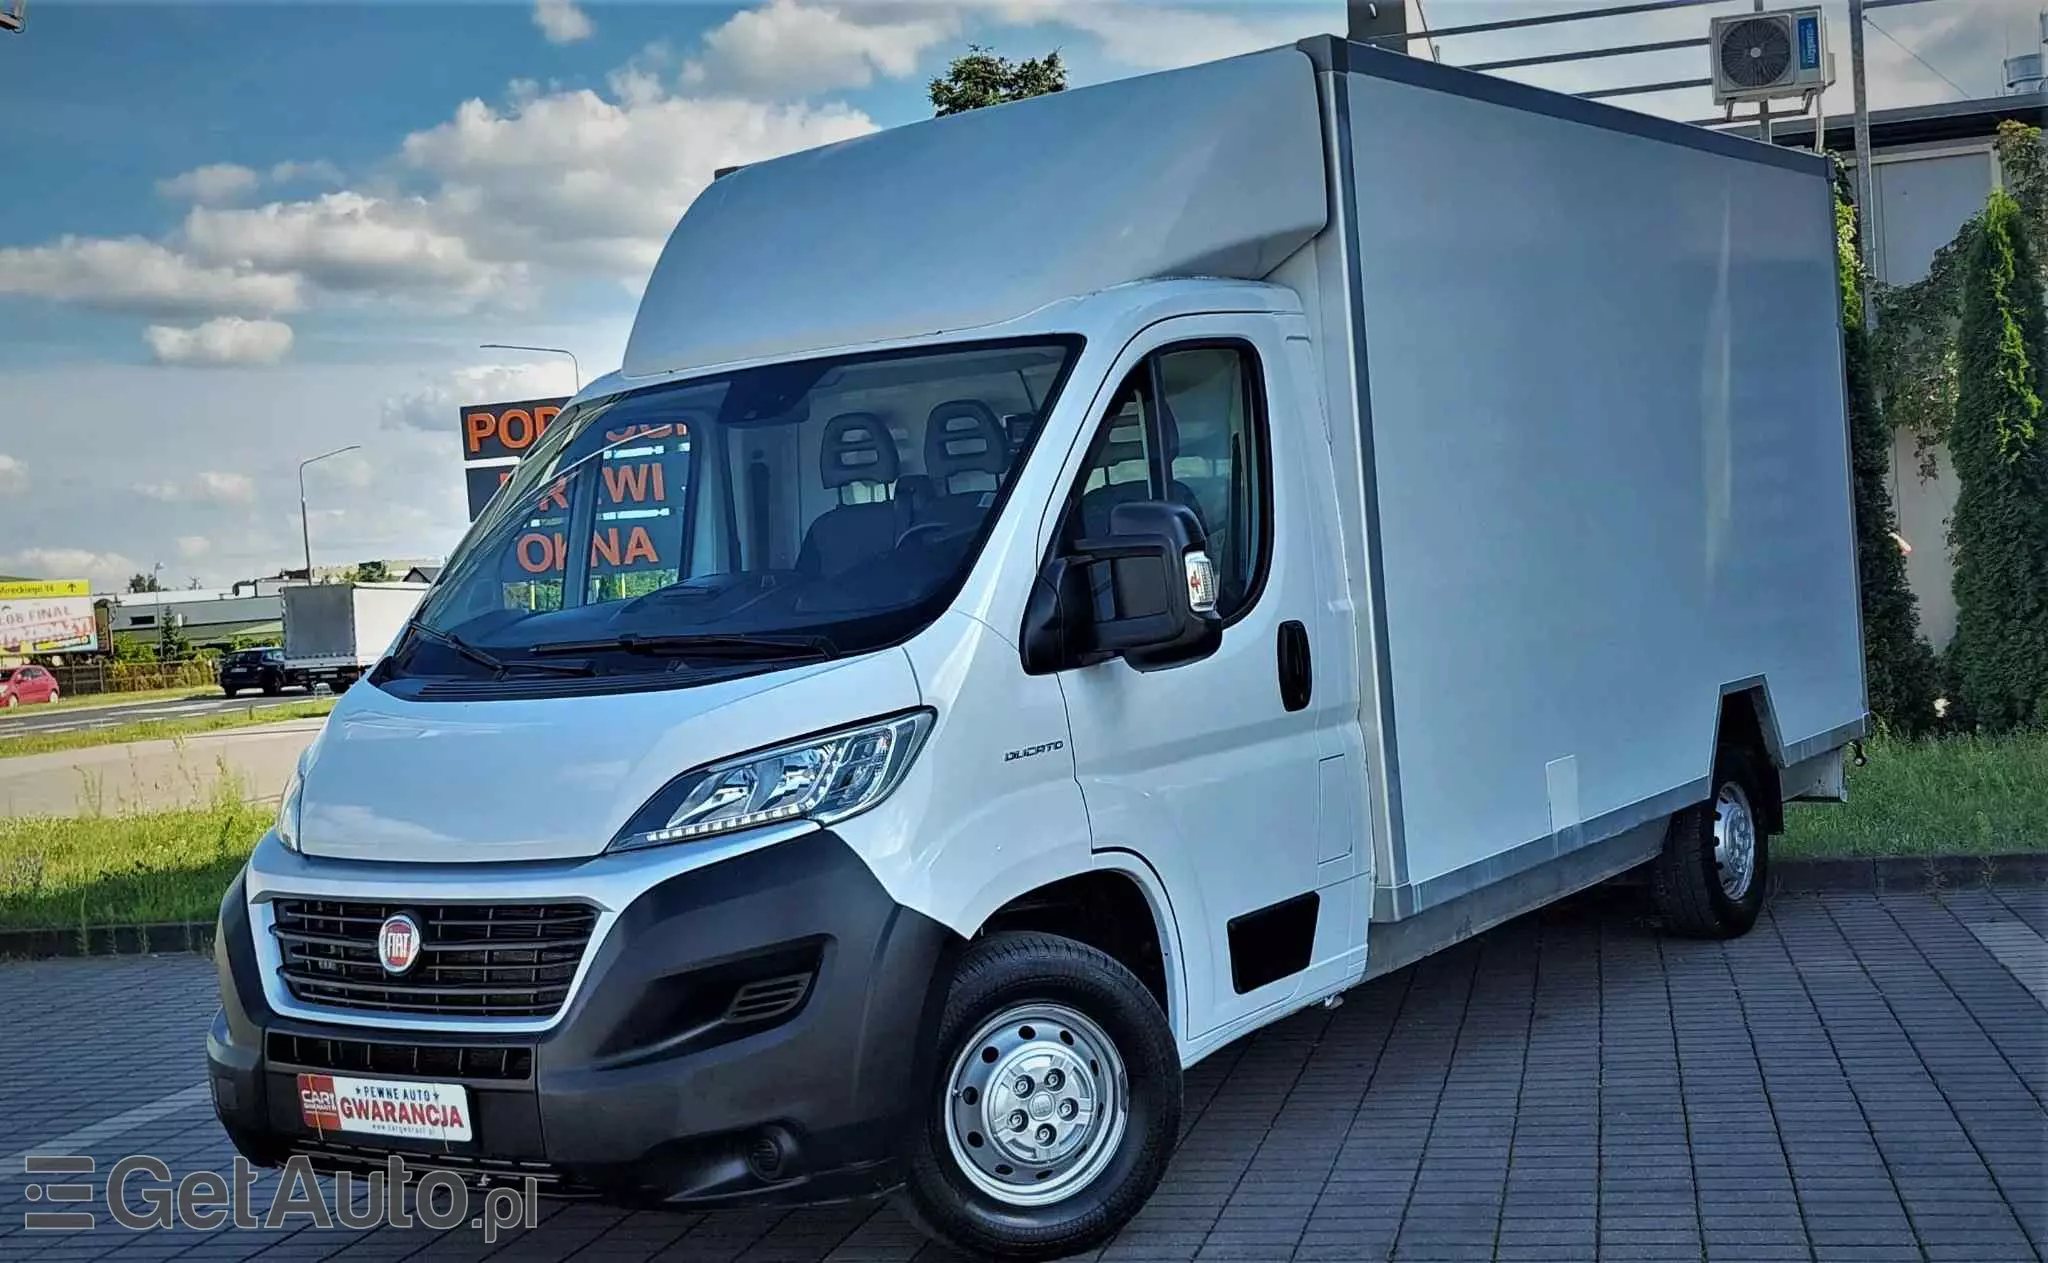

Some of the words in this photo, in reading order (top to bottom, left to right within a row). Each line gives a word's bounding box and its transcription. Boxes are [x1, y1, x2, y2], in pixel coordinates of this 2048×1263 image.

[28, 606, 72, 621] FINAL
[1004, 740, 1064, 761] DUCATO
[387, 932, 411, 958] FIAT
[363, 1086, 399, 1099] PEWNE
[403, 1089, 431, 1102] AUTO
[340, 1097, 464, 1128] GWARANCJA
